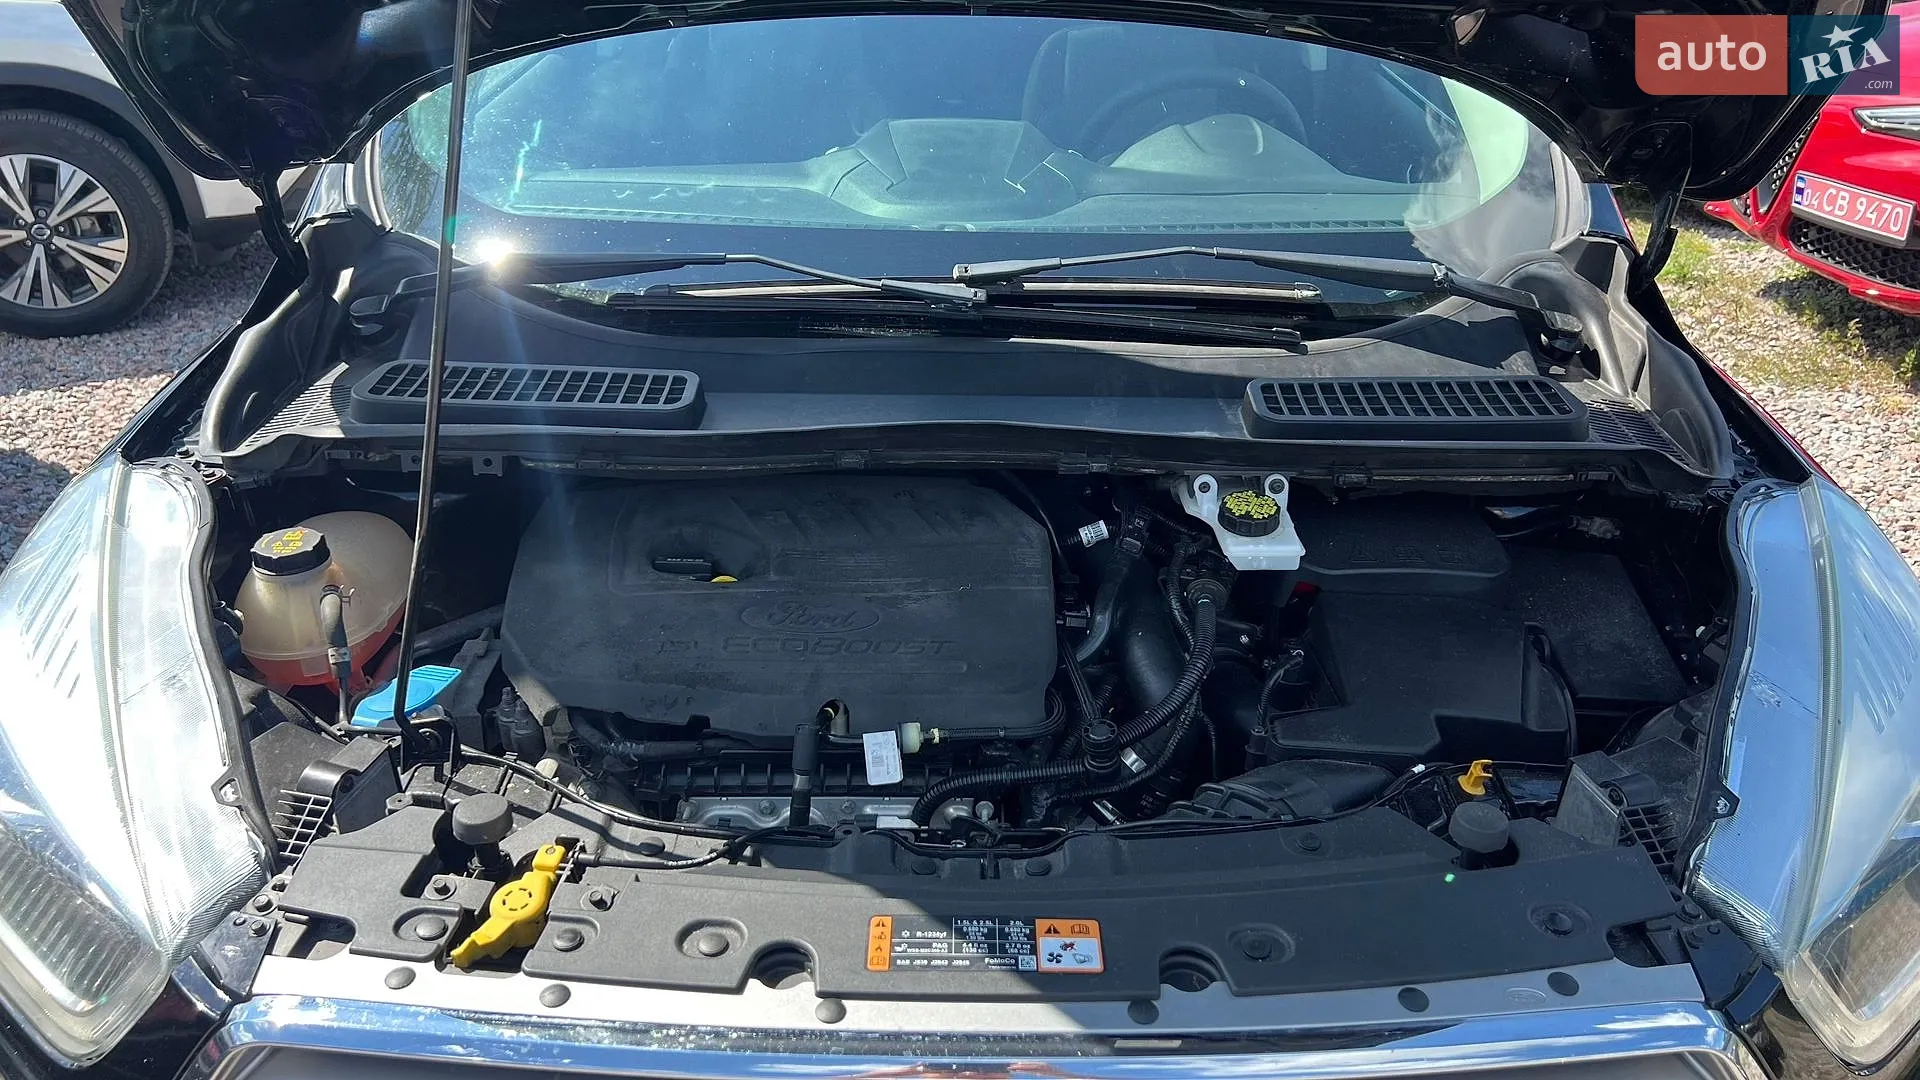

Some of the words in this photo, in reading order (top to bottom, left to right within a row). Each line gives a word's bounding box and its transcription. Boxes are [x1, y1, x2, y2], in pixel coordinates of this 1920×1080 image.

[1803, 189, 1821, 210] 04
[1823, 188, 1850, 216] CB
[1855, 197, 1904, 232] 9470
[766, 600, 858, 627] Ford
